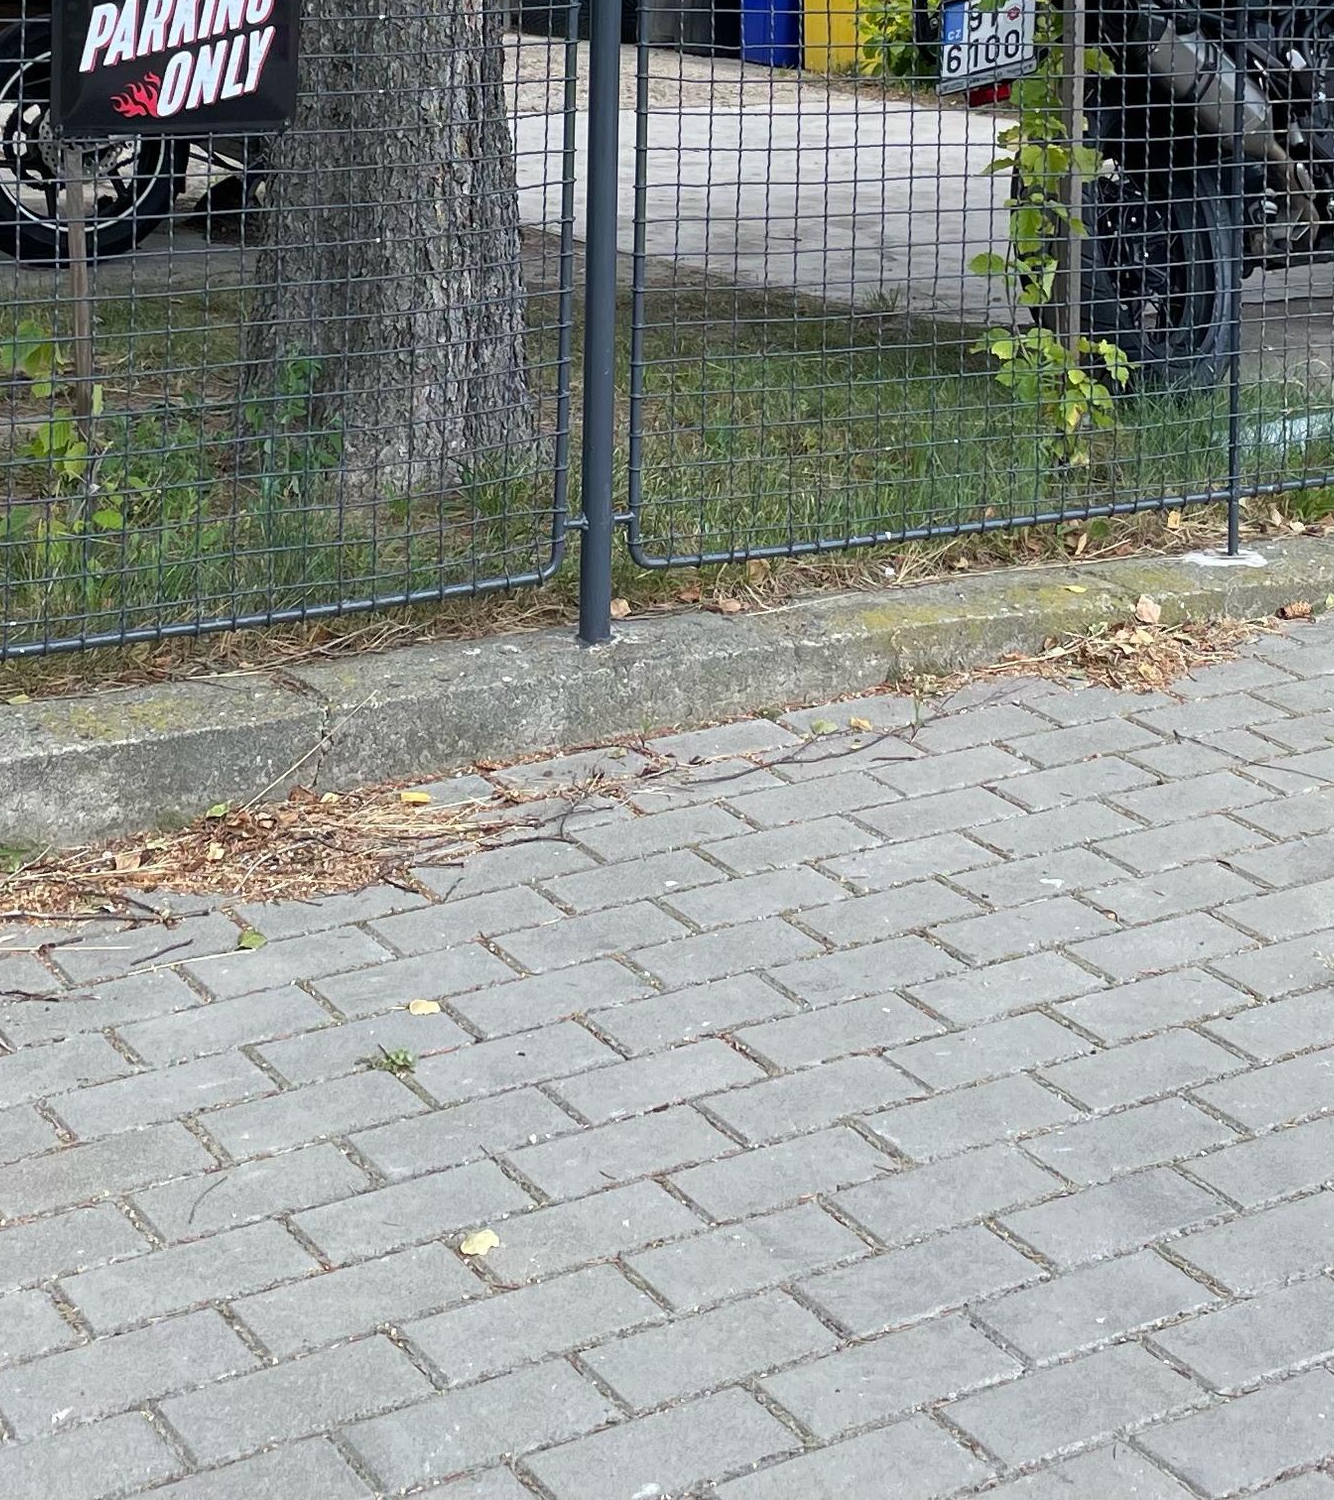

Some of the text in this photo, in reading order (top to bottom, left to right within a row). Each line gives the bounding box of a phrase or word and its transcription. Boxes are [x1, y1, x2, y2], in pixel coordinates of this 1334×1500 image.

[946, 29, 1020, 74] 6100
[947, 29, 962, 42] CZ
[155, 25, 277, 118] ONLY
